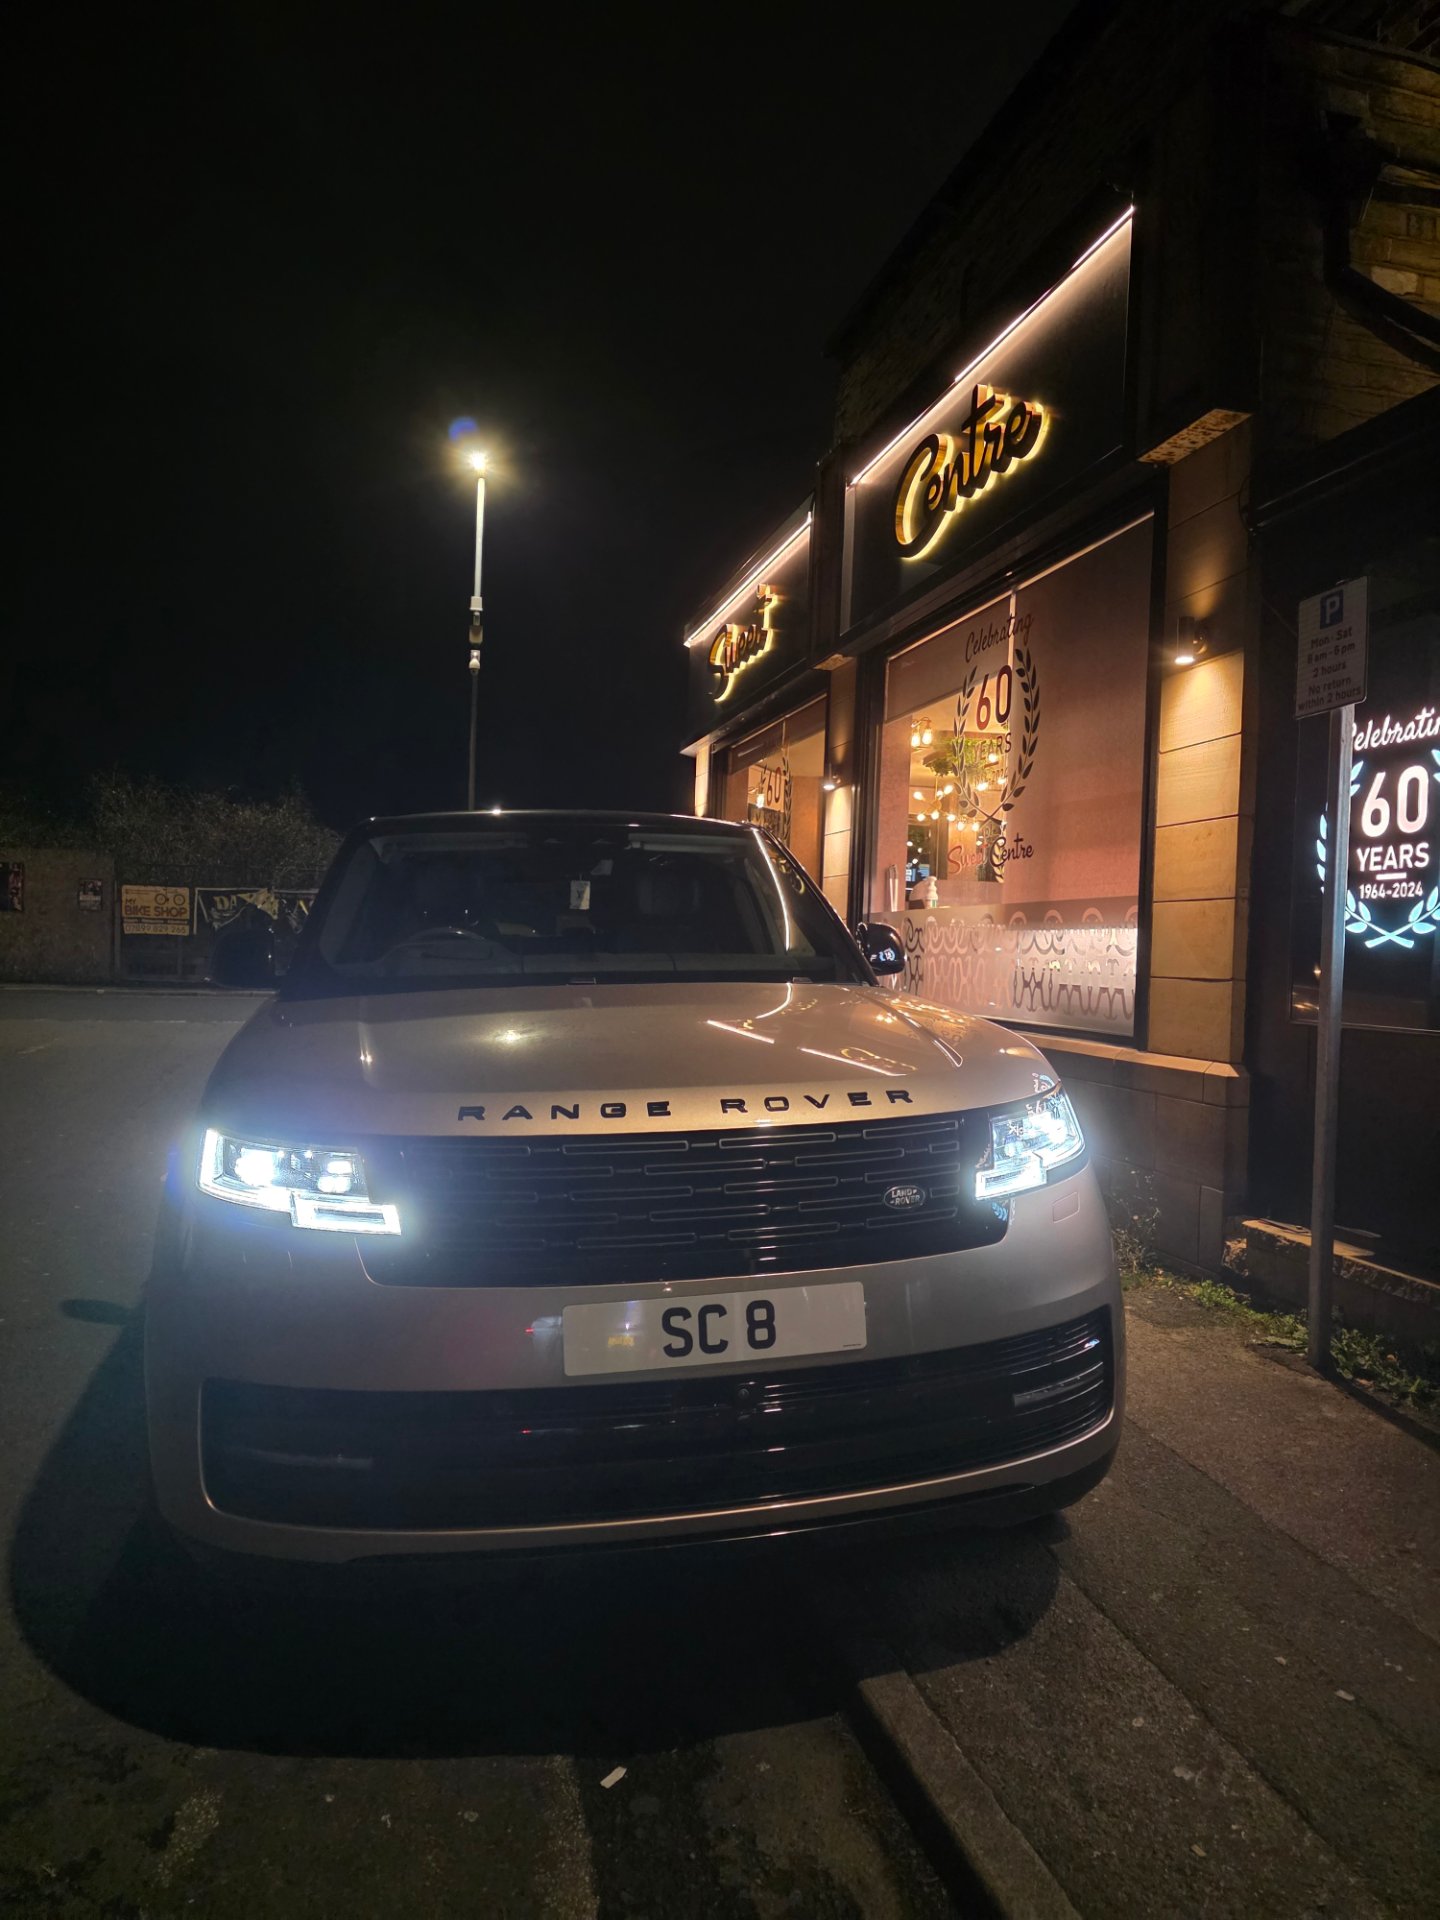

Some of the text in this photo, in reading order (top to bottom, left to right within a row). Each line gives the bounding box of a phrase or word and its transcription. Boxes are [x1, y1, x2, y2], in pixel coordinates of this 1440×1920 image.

[895, 384, 1049, 560] Centre
[1326, 596, 1340, 624] P
[965, 613, 1034, 663] Celebrating
[1311, 635, 1330, 650] Mon
[1336, 626, 1353, 640] Sat
[1313, 662, 1346, 678] 2 hours
[976, 665, 1013, 730] 60
[1298, 687, 1361, 711] within 2 hours
[1308, 677, 1351, 697] No return
[974, 732, 1012, 767] YEARS
[767, 767, 782, 806] 60
[1361, 765, 1429, 838] 60
[990, 832, 1034, 867] Centre
[1356, 842, 1429, 872] YEARS
[1359, 881, 1423, 899] 1964-2024
[125, 905, 187, 917] BIKE SHOP
[457, 1089, 914, 1121] RANGE ROVER
[892, 1189, 912, 1198] LAND
[895, 1195, 920, 1205] ROVER
[661, 1299, 776, 1358] SC 8
